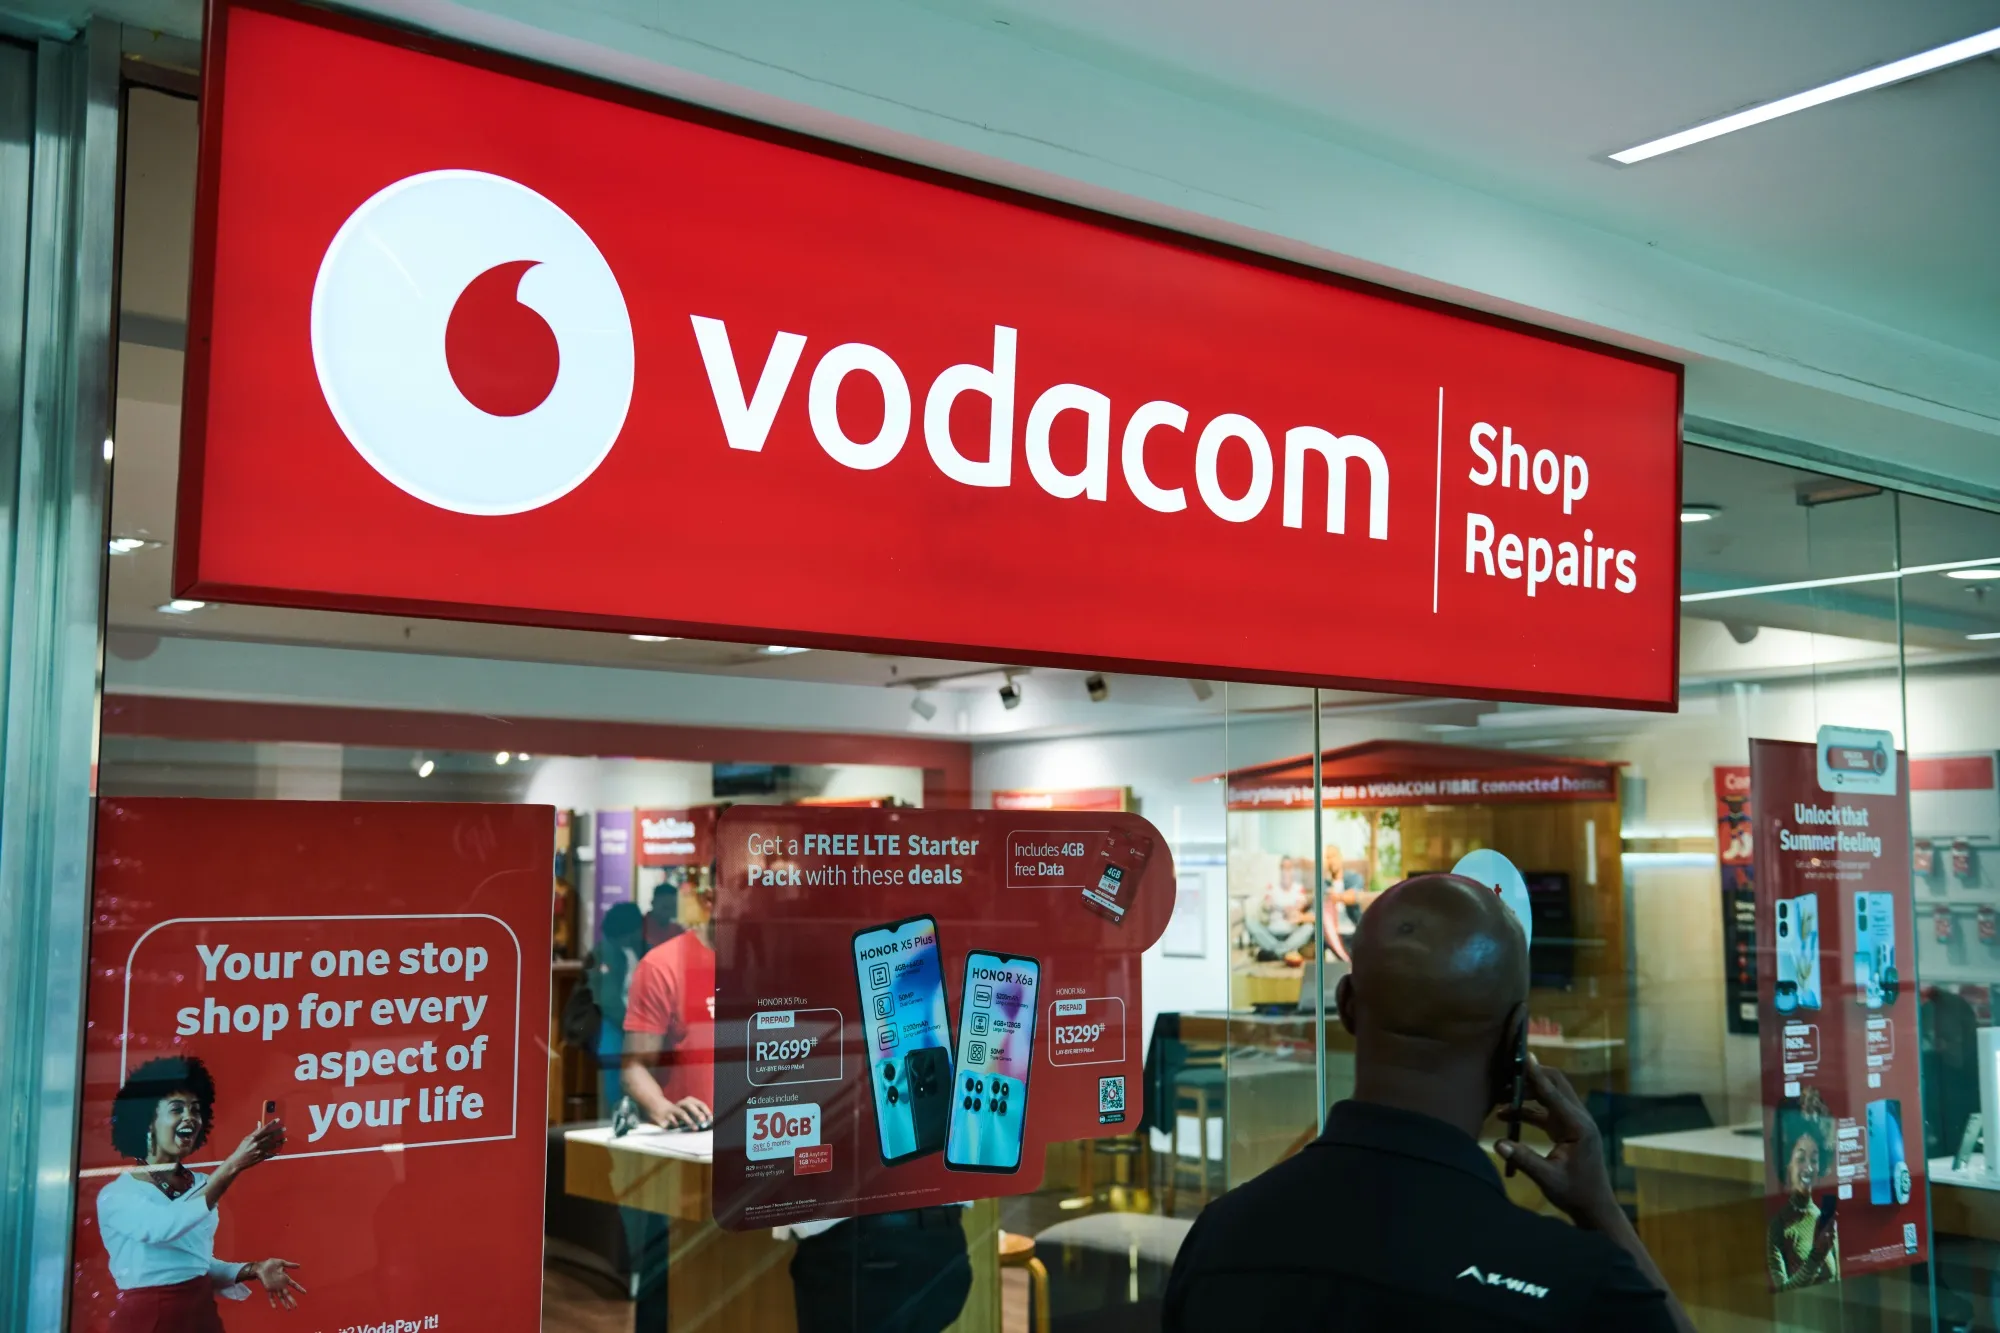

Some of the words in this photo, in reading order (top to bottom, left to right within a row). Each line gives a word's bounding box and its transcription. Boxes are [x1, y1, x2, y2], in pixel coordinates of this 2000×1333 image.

[690, 314, 1388, 540] vodacom
[1468, 422, 1589, 515] Shop
[1465, 512, 1637, 597] Repairs
[1367, 781, 1437, 798] VODACOM
[1439, 778, 1479, 795] FIBRE
[1482, 777, 1559, 794] connected
[1562, 776, 1607, 792] home
[1795, 802, 1840, 825] Unlock
[1841, 806, 1869, 827] that
[748, 833, 782, 855] Get
[788, 839, 798, 855] a
[804, 834, 859, 856] FREE
[864, 835, 900, 856] LTE
[908, 835, 979, 855] Starter
[1015, 842, 1059, 857] Includes
[1061, 843, 1085, 857] 4GB
[1780, 829, 1836, 851] Summer
[1837, 831, 1881, 858] feeling
[748, 864, 801, 886] Pack
[806, 865, 847, 886] with
[852, 864, 903, 886] these
[908, 864, 962, 885] deals
[1014, 863, 1035, 876] free
[1038, 862, 1065, 876] Data
[1107, 867, 1121, 879] 4GB
[860, 943, 898, 961] HONOR
[900, 940, 913, 951] X5
[914, 936, 933, 948] Plus
[196, 944, 302, 981] Your
[310, 948, 389, 977] one
[399, 942, 488, 981] stop
[972, 968, 1012, 983] HONOR
[1015, 973, 1033, 986] X6a
[757, 998, 783, 1007] HONOR
[783, 997, 793, 1005] X5
[794, 996, 808, 1005] Plus
[176, 997, 289, 1041] shop
[298, 993, 362, 1030] for
[370, 995, 488, 1031] every
[760, 1015, 790, 1025] PREPAID
[295, 1040, 436, 1087] aspect
[445, 1035, 488, 1071] of
[747, 1097, 757, 1105] 4G
[757, 1095, 775, 1104] deals
[775, 1094, 799, 1102] include
[308, 1098, 410, 1142] your
[418, 1085, 484, 1123] life
[424, 1314, 439, 1330] it!
